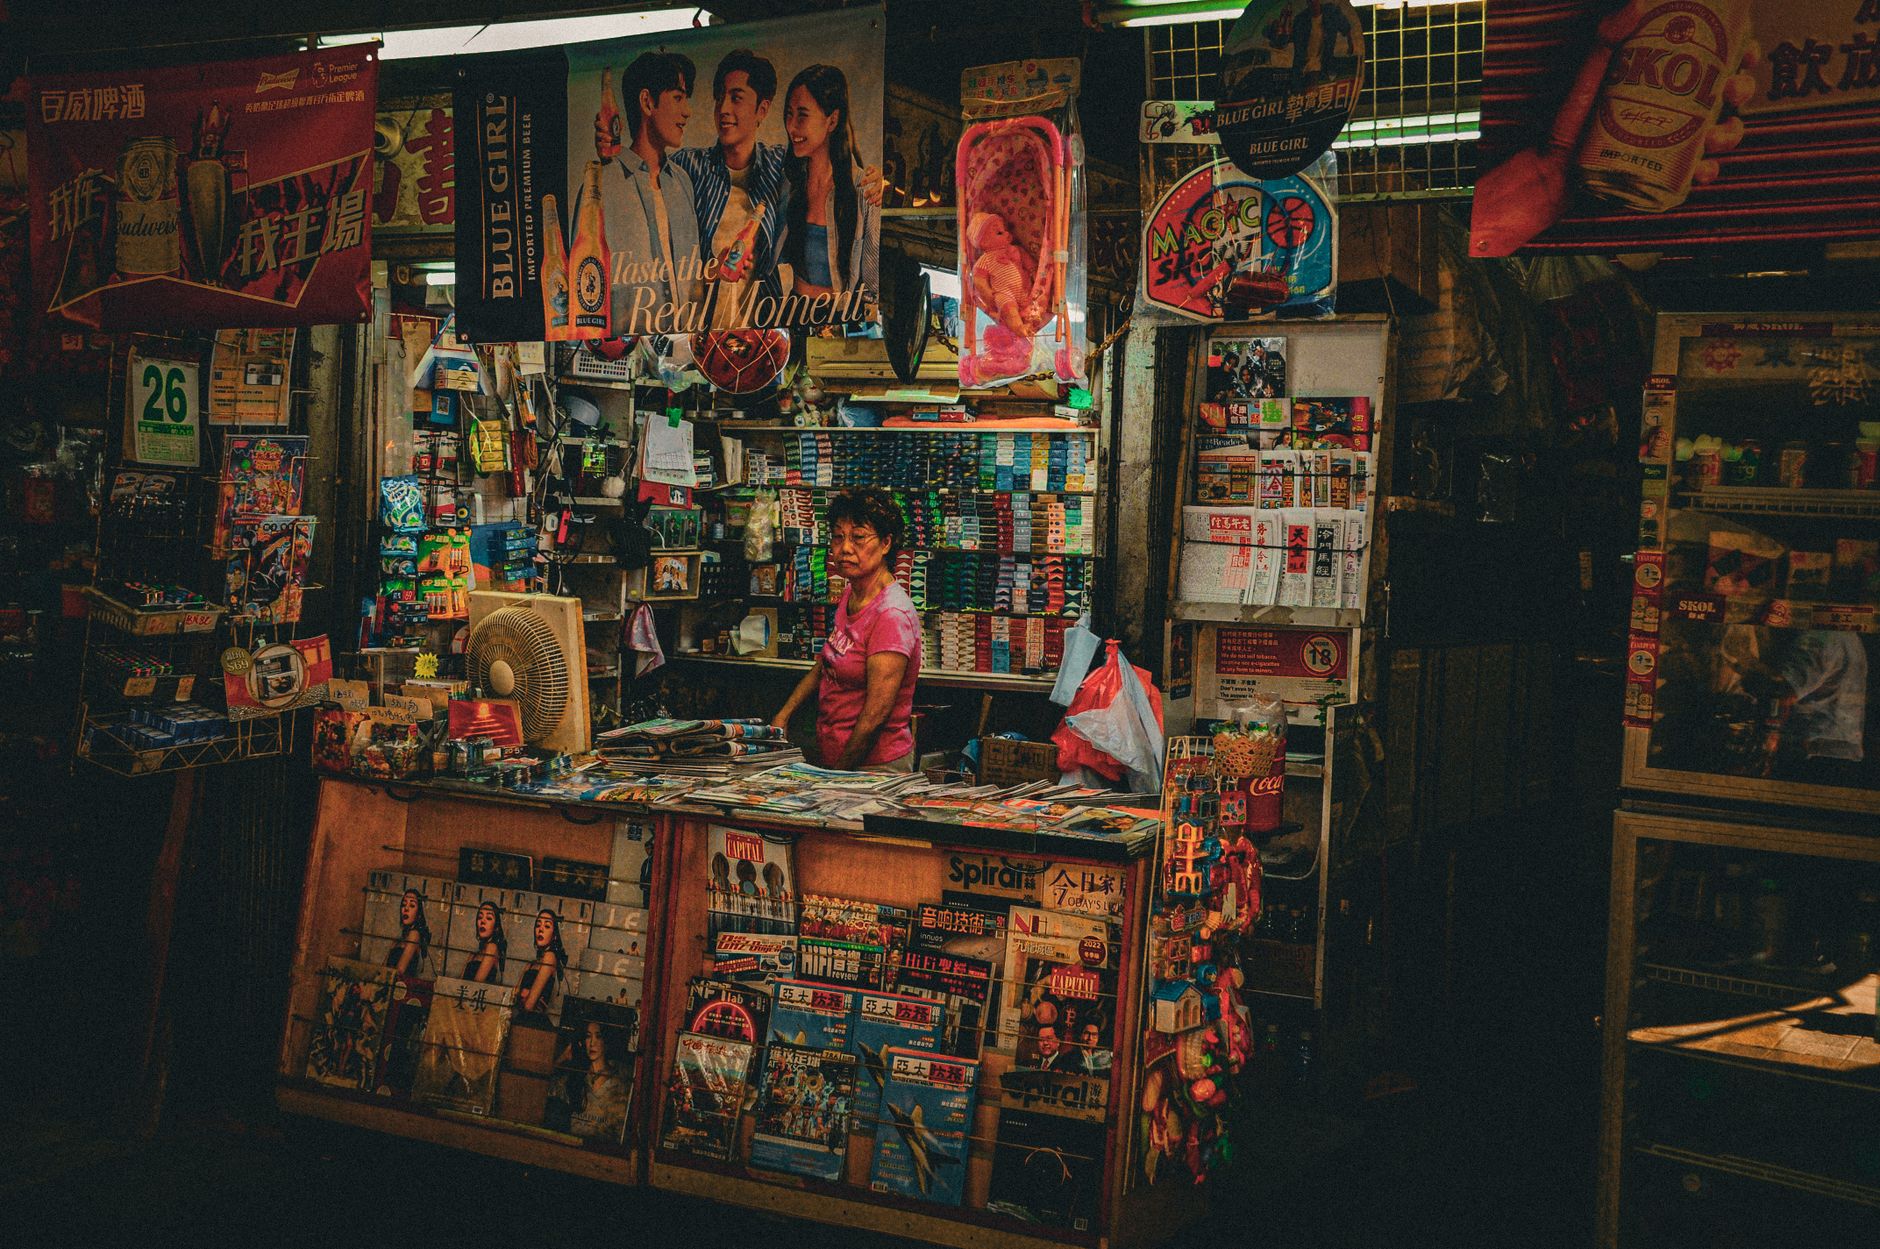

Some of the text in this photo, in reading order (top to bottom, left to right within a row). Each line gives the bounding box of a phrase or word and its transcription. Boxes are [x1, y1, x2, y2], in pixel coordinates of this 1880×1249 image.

[329, 63, 358, 73] Premier
[329, 73, 357, 83] League
[41, 84, 145, 123] 百威啤酒
[1217, 101, 1285, 127] BLUE GIRL
[1250, 137, 1309, 155] BLUE GIRL
[1600, 149, 1663, 171] IMPORTED
[487, 95, 515, 299] BLUE GIRL
[526, 113, 536, 281] IMPORTED PREMIUM BEER
[239, 190, 367, 276] 我主場
[1151, 196, 1261, 260] MAGIC
[611, 246, 719, 285] Taste the
[577, 316, 592, 326] BLUE
[624, 282, 709, 337] Real
[143, 365, 187, 422] 26
[1678, 600, 1716, 614] SKOL
[1309, 649, 1331, 666] 18
[949, 856, 1023, 890] Spiral
[1084, 940, 1101, 949] 2022
[832, 970, 859, 981] review
[1050, 974, 1099, 1000] CAPITAL
